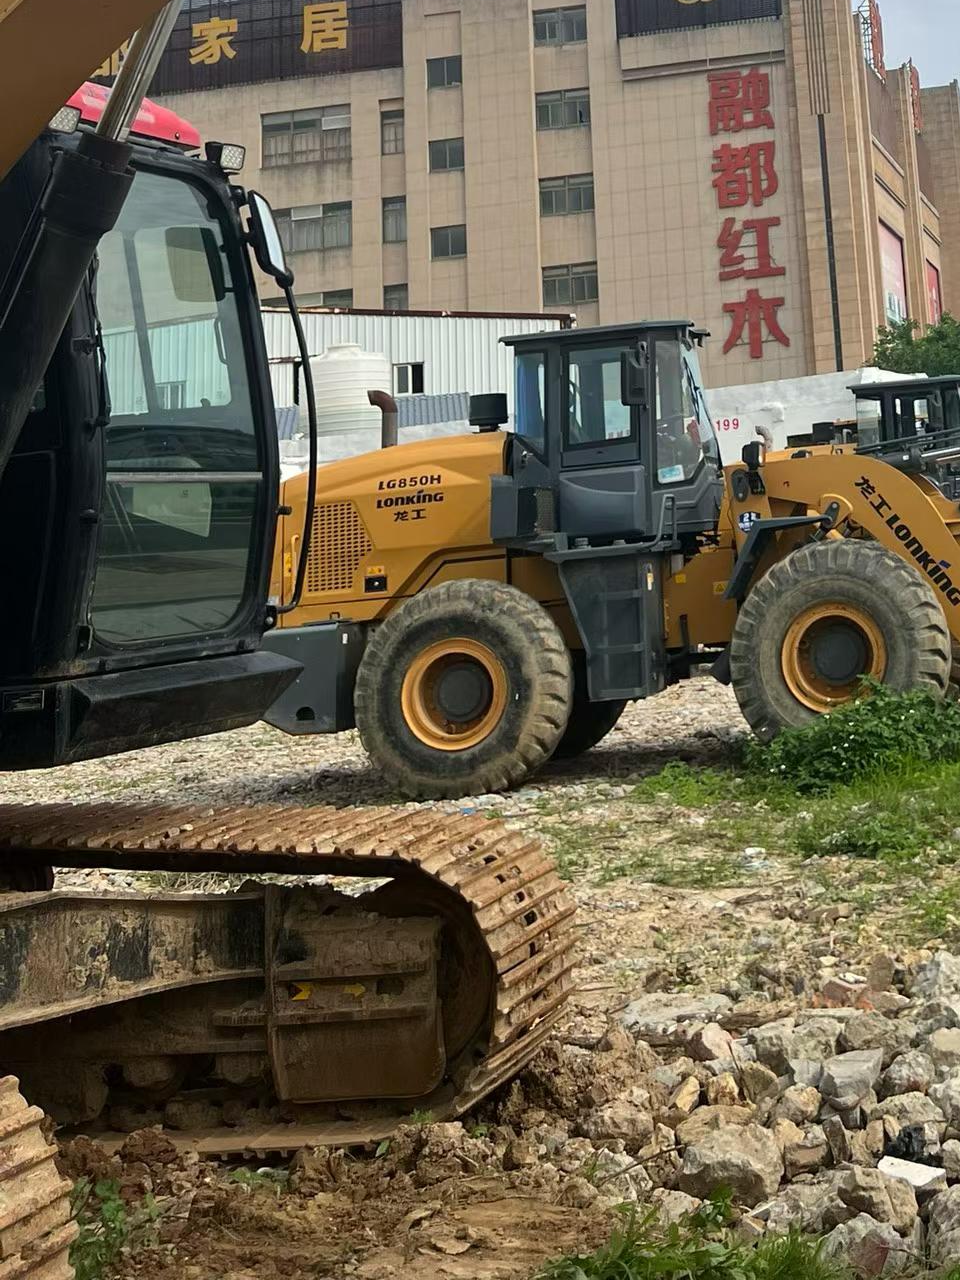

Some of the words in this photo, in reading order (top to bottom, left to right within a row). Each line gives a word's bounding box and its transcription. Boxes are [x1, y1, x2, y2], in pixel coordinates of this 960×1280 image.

[707, 67, 790, 359] 融都红木
[716, 418, 739, 431] 199
[378, 474, 442, 491] LG850H
[854, 476, 891, 518] 龙工
[394, 508, 427, 522] 龙工
